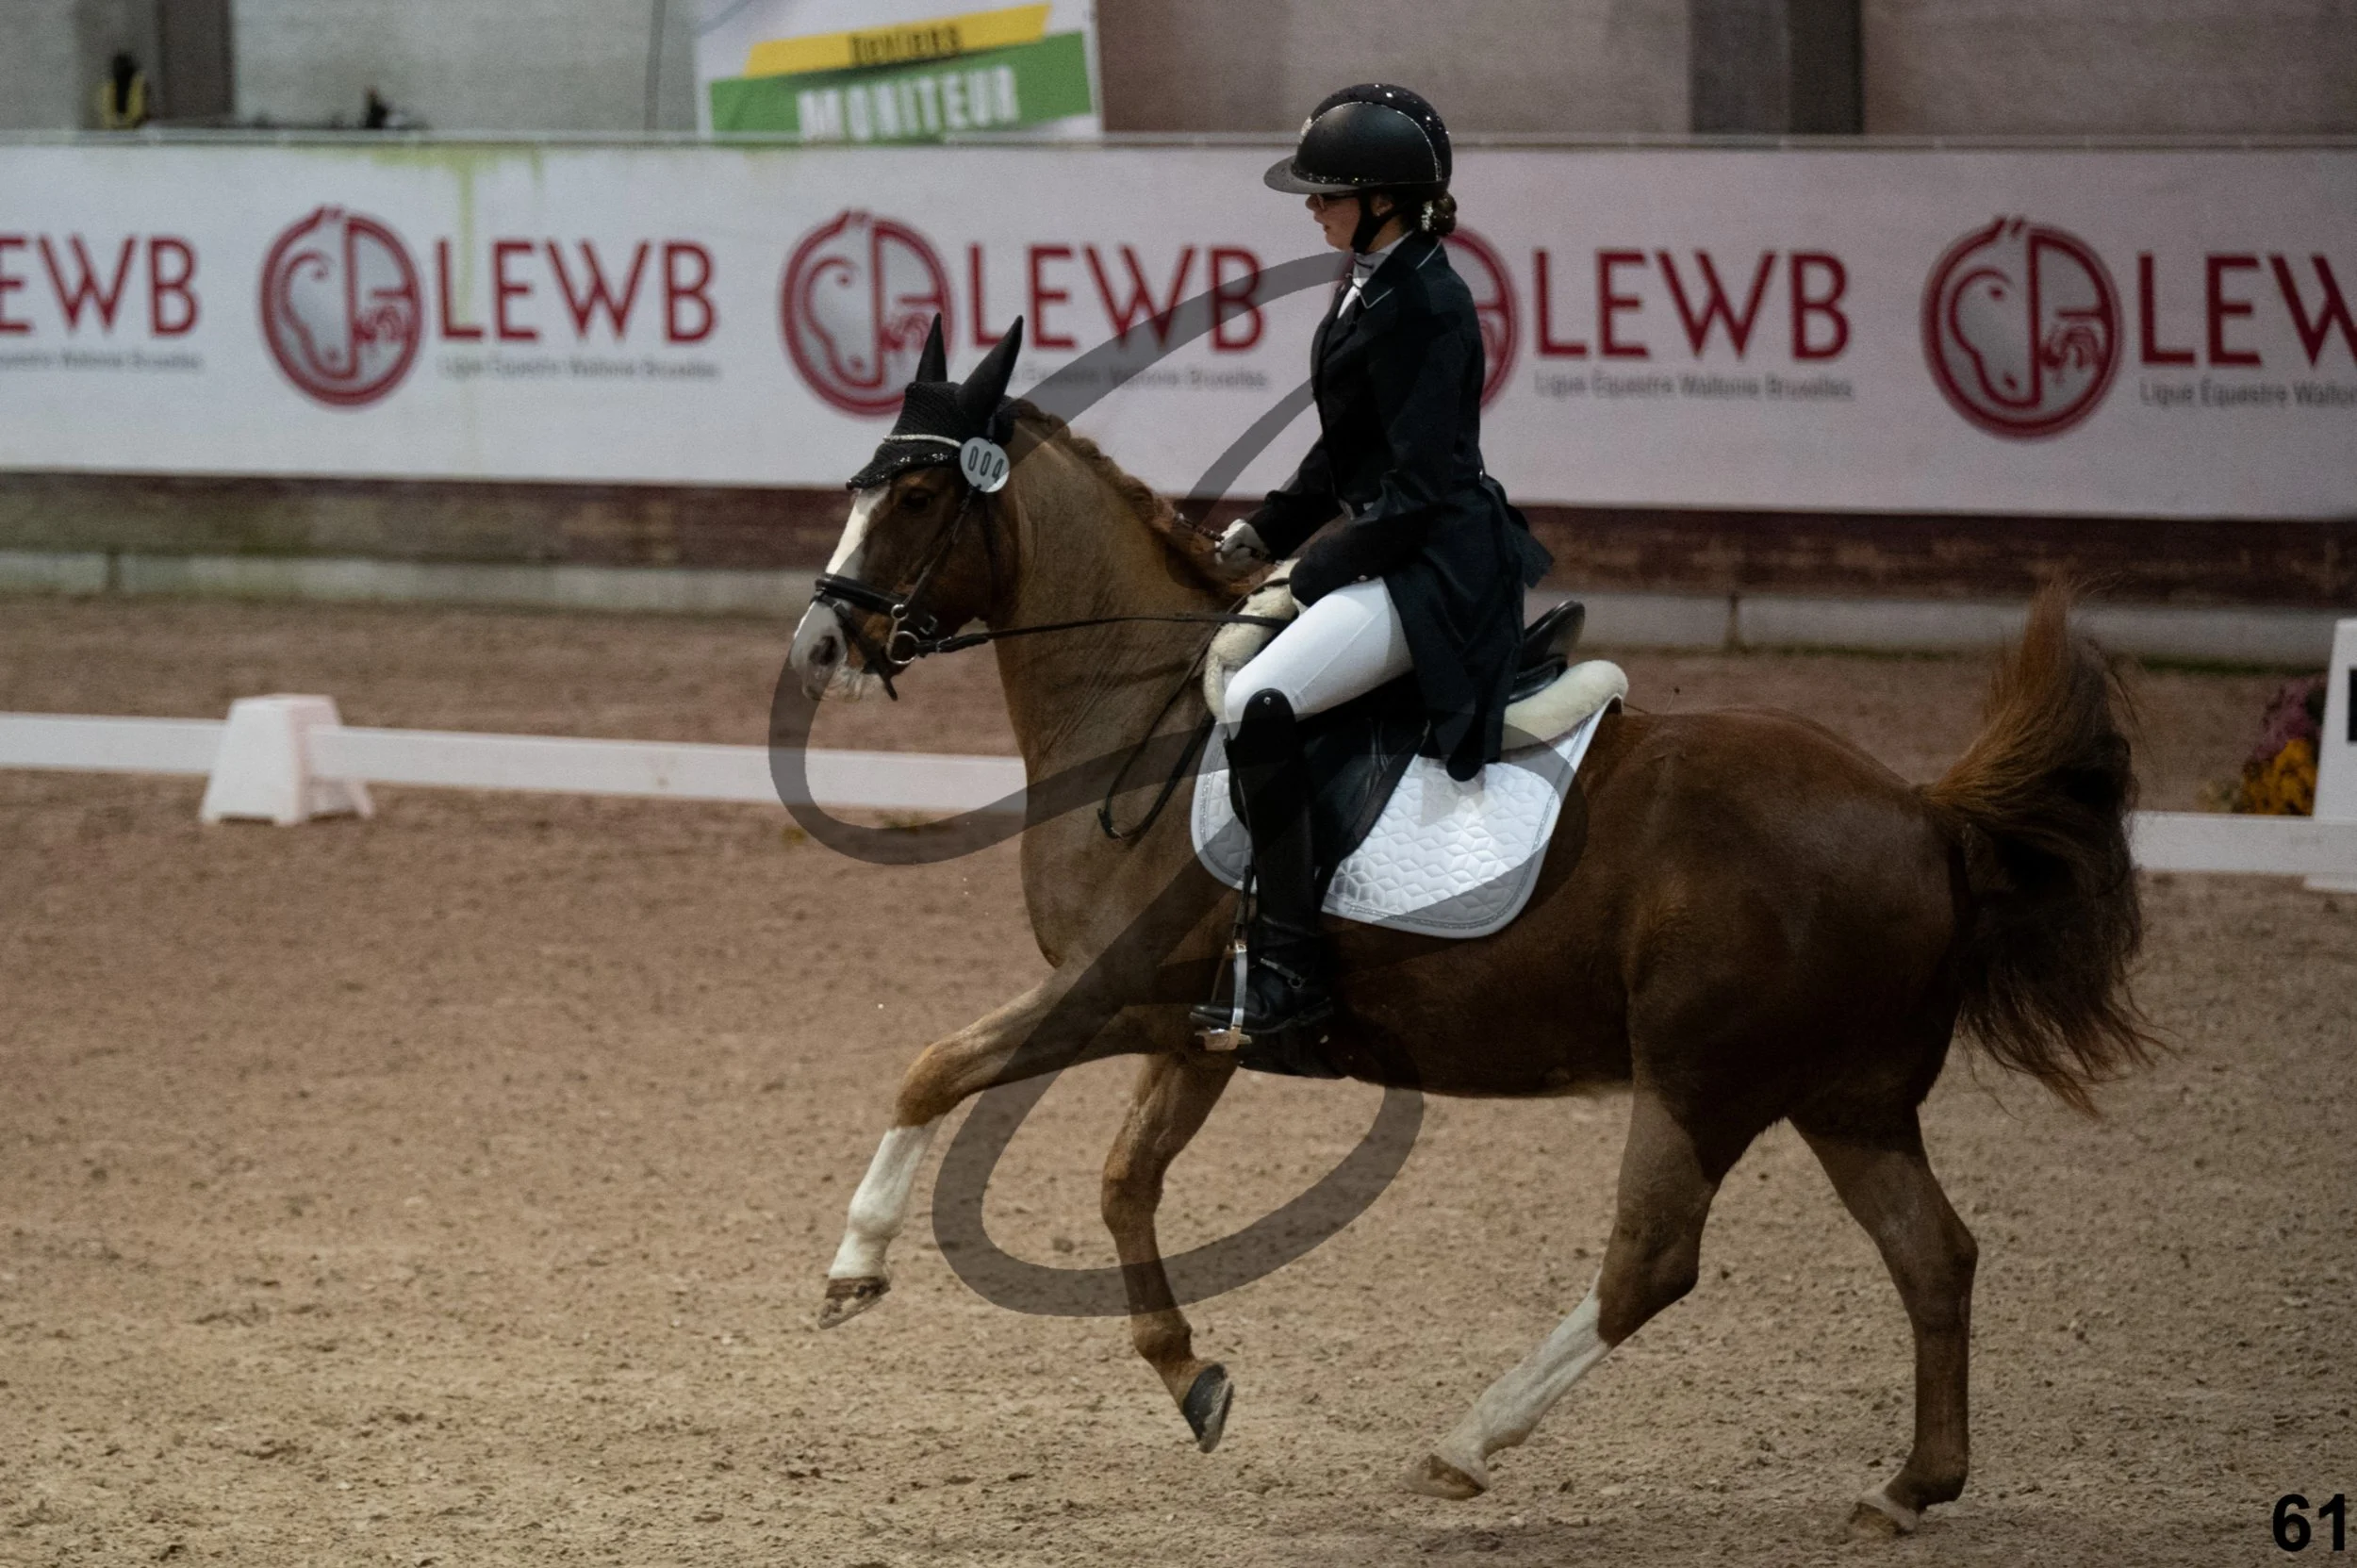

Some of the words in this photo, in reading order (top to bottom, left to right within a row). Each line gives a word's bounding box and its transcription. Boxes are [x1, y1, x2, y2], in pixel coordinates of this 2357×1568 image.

[436, 237, 716, 343] LEWB
[967, 243, 1265, 353] LEWB
[1531, 247, 1853, 360] LEWB
